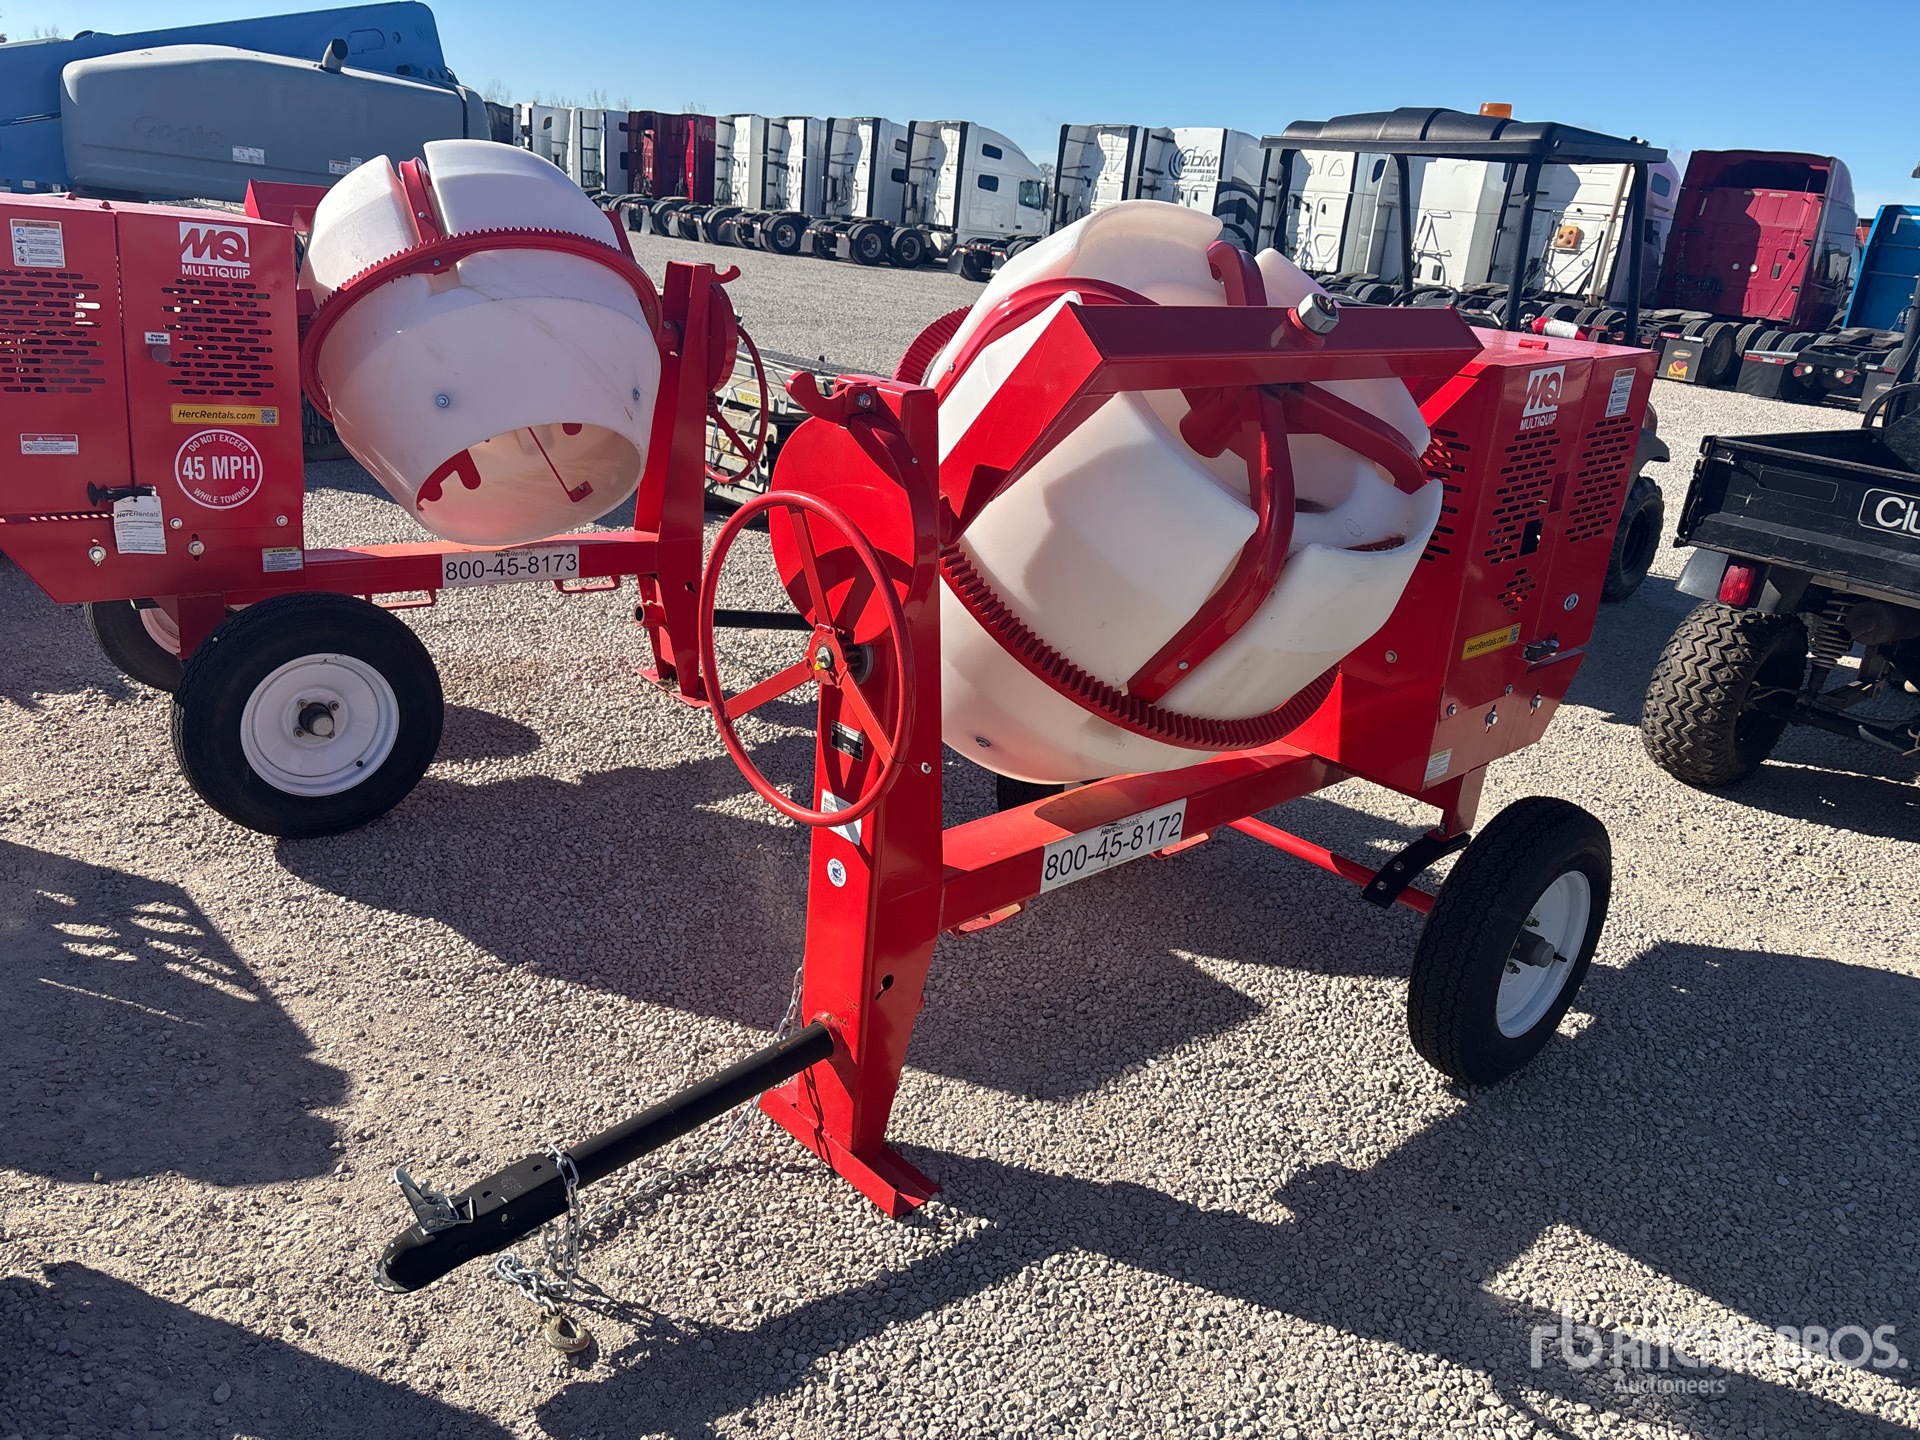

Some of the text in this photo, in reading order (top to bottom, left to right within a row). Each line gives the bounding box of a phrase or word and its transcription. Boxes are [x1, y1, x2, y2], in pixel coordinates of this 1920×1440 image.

[179, 225, 250, 265] MQ
[181, 264, 251, 280] MULTIQUIP
[1524, 368, 1563, 411] MQ
[178, 409, 256, 420] HercRentals.com
[1520, 412, 1557, 431] MULTIQUIP
[188, 434, 249, 453] DO NOT EXCEED
[182, 456, 256, 481] 45 MPH
[193, 485, 250, 504] WHILE TOWING
[116, 510, 161, 519] HercRentals
[494, 550, 533, 558] HercRentals
[445, 553, 578, 581] 800-45-8173
[1466, 634, 1508, 653] HercRentals.com
[1099, 817, 1142, 836] HercRentals
[1044, 811, 1183, 882] 800-45-8172
